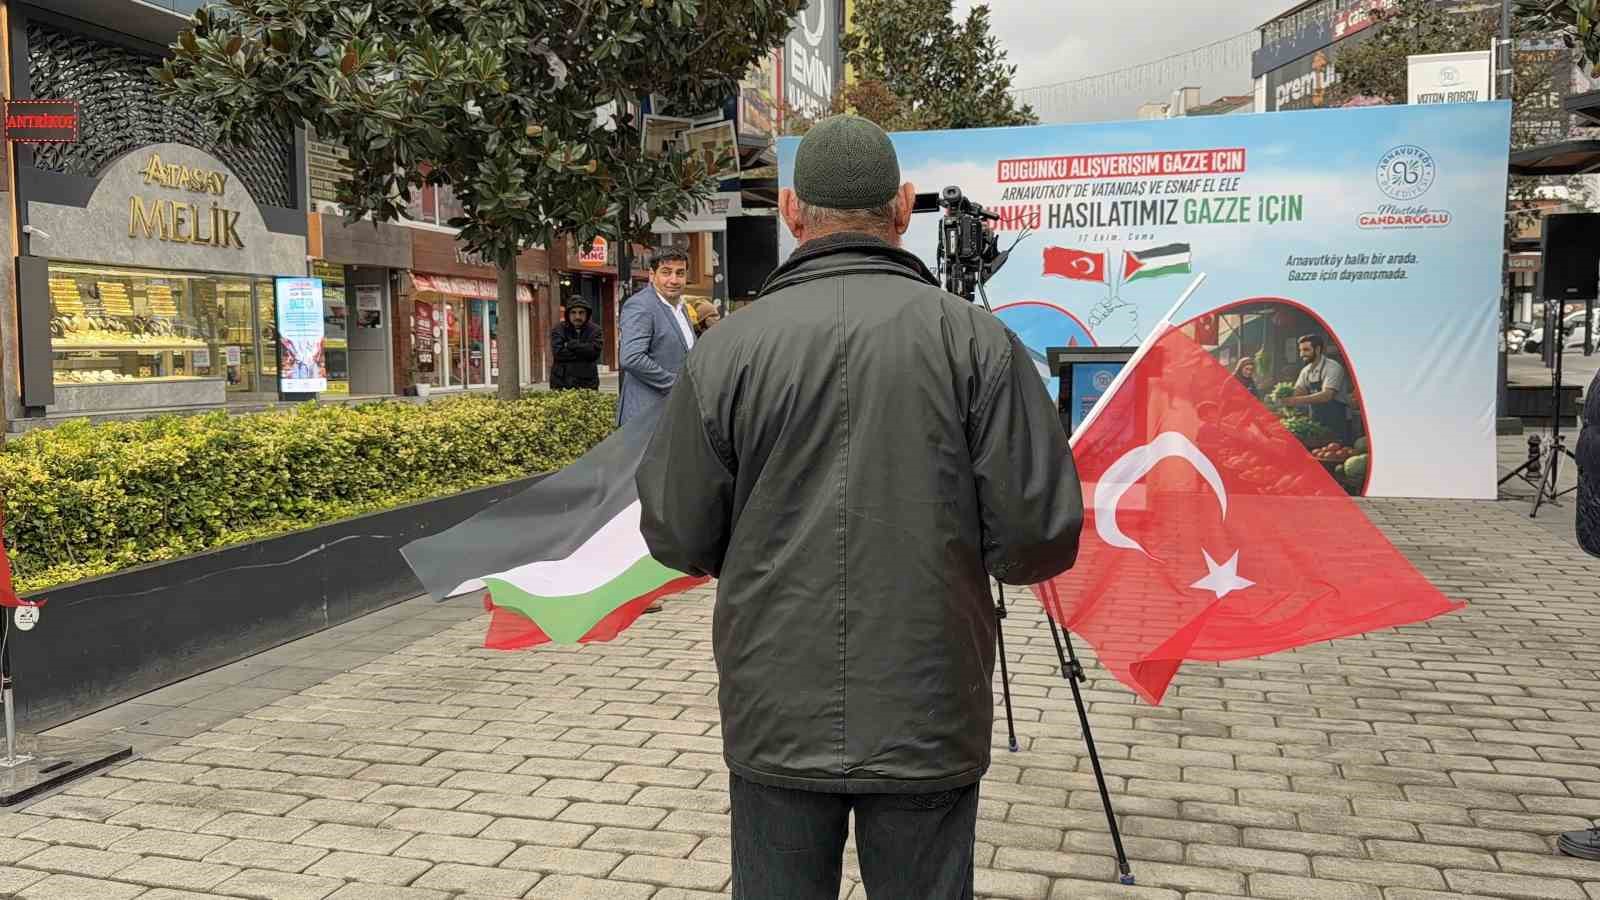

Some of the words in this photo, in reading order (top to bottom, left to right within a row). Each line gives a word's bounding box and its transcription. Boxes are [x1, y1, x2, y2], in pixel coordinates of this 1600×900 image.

[791, 37, 831, 102] EMİN
[140, 151, 228, 196] ATASAY
[1163, 152, 1208, 173] GAZZE
[1149, 179, 1164, 194] VE
[1164, 178, 1201, 193] ESNAF
[1202, 178, 1216, 192] EL
[1218, 177, 1240, 192] ELE
[128, 194, 244, 249] MELİK
[1048, 199, 1178, 229] HASILATIMIZ
[1184, 196, 1251, 224] GAZZE
[1258, 194, 1303, 225] İÇİN
[1285, 254, 1343, 268] Arnavutköy
[1344, 253, 1370, 266] halkı
[1371, 252, 1387, 265] bir
[1387, 252, 1419, 265] arada.
[1288, 270, 1318, 282] Gazze
[1319, 269, 1338, 281] için
